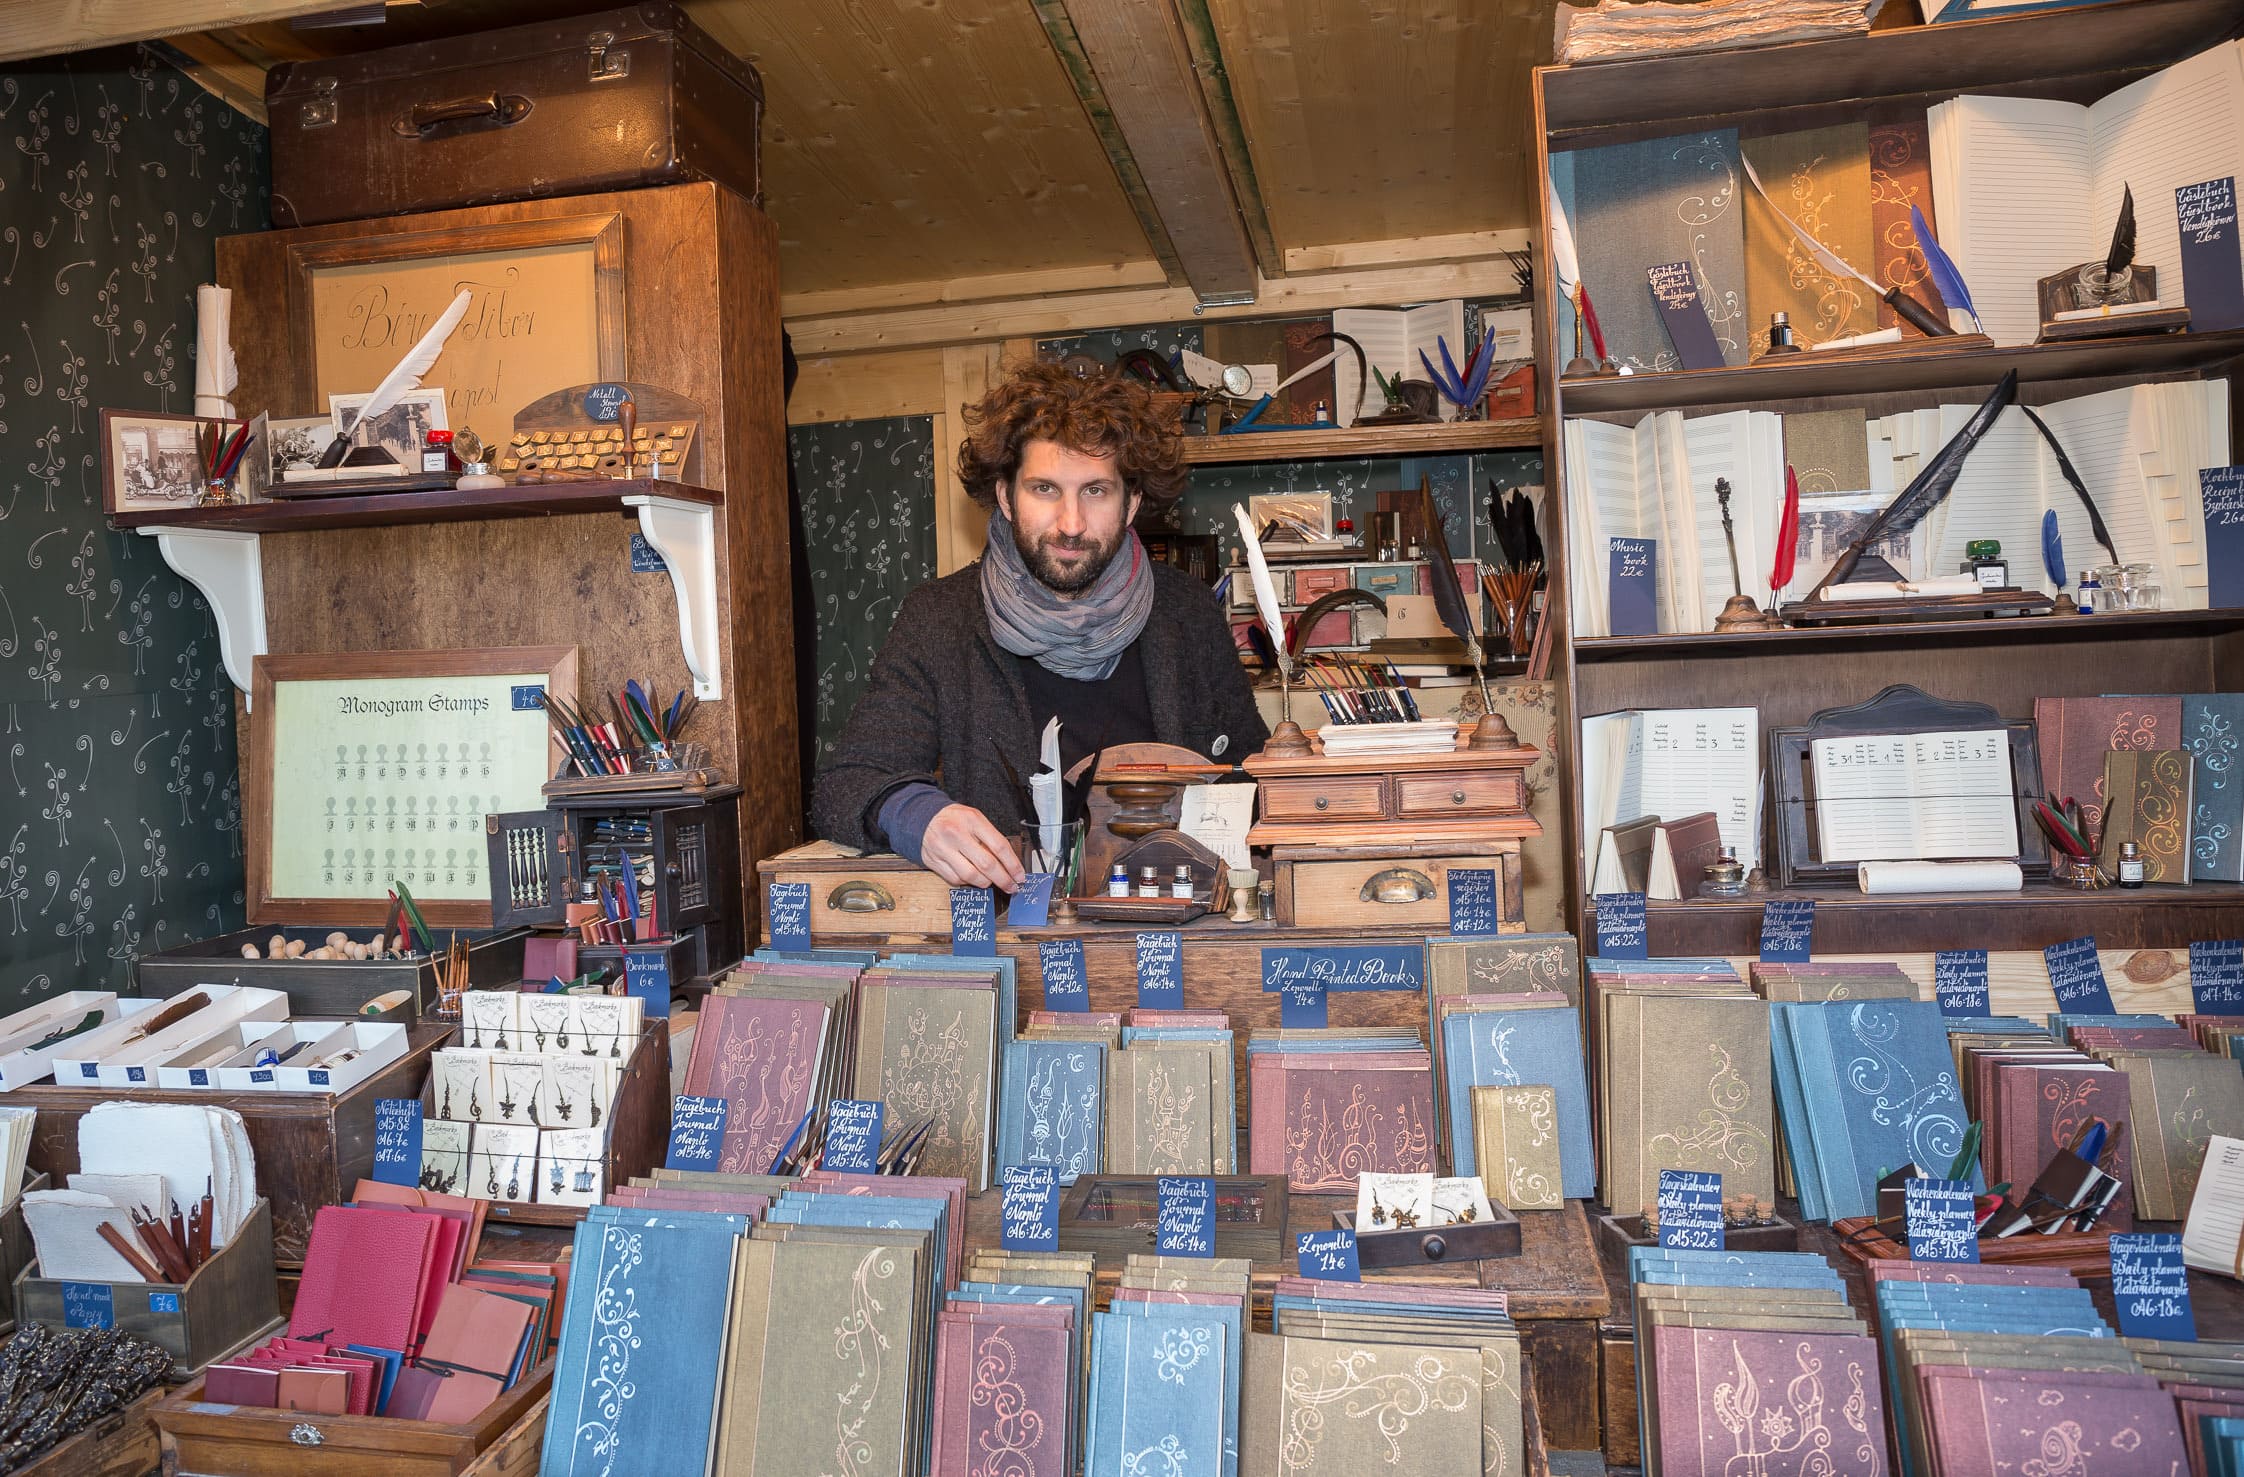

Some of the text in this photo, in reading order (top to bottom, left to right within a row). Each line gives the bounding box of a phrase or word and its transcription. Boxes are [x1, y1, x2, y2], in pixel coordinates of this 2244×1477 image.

[2178, 195, 2234, 218] Guestbook
[2195, 230, 2221, 243] 26€
[1610, 539, 1645, 552] Music
[1624, 554, 1648, 566] book
[1620, 566, 1644, 576] 22€
[337, 693, 489, 717] Monogram Stamps
[1711, 739, 1718, 749] 3
[770, 884, 808, 899] Tagebuch
[950, 890, 990, 904] Tagebuch
[771, 898, 806, 915] Journal
[953, 903, 987, 921] Journal
[775, 910, 800, 926] Napló
[956, 915, 985, 930] Napló
[958, 929, 989, 942] A5:16€
[1136, 934, 1177, 950] Tagebuch
[1605, 934, 1640, 947] A5:22€
[1039, 942, 1081, 957] Tagebuch
[1137, 948, 1175, 969] Journal
[1048, 968, 1077, 982] Napló
[1142, 963, 1170, 978] Napló
[1266, 955, 1309, 985] Hand
[1312, 958, 1359, 985] Painted
[640, 973, 654, 987] 6€
[1050, 981, 1083, 994] A6:12€
[2060, 981, 2099, 1001] A6:16€
[1945, 993, 1982, 1008] A6:18€
[375, 1099, 420, 1121] Notizheft
[675, 1096, 725, 1117] Tagebuch
[831, 1100, 878, 1119] Tagebuch
[378, 1118, 410, 1131] A5:8€
[672, 1113, 719, 1130] Journal
[827, 1117, 872, 1141] Journal
[377, 1132, 408, 1147] A6:7€
[675, 1129, 710, 1148] Napló
[830, 1136, 867, 1155] Napló
[376, 1149, 407, 1162] A7:6€
[828, 1153, 870, 1168] A5:16€
[1004, 1167, 1056, 1191] Tagebuch
[1002, 1184, 1051, 1209] Journal
[1159, 1178, 1209, 1198] Tagebuch
[1159, 1197, 1206, 1223] Journal
[1658, 1192, 1722, 1213] Daily planner
[1906, 1199, 1975, 1221] Weekly planner
[1006, 1201, 1044, 1224] Napló
[1007, 1222, 1053, 1239] A6:12€
[1164, 1215, 1202, 1237] Napló
[1163, 1235, 1206, 1252] A6:14€
[1298, 1232, 1353, 1257] Leporello
[1667, 1229, 1717, 1248] A5:22€
[1915, 1240, 1969, 1259] A5:18€
[1321, 1253, 1346, 1271] 14€
[2112, 1257, 2148, 1276] Daily
[156, 1295, 174, 1311] 7€
[2130, 1298, 2183, 1317] A6:18€
